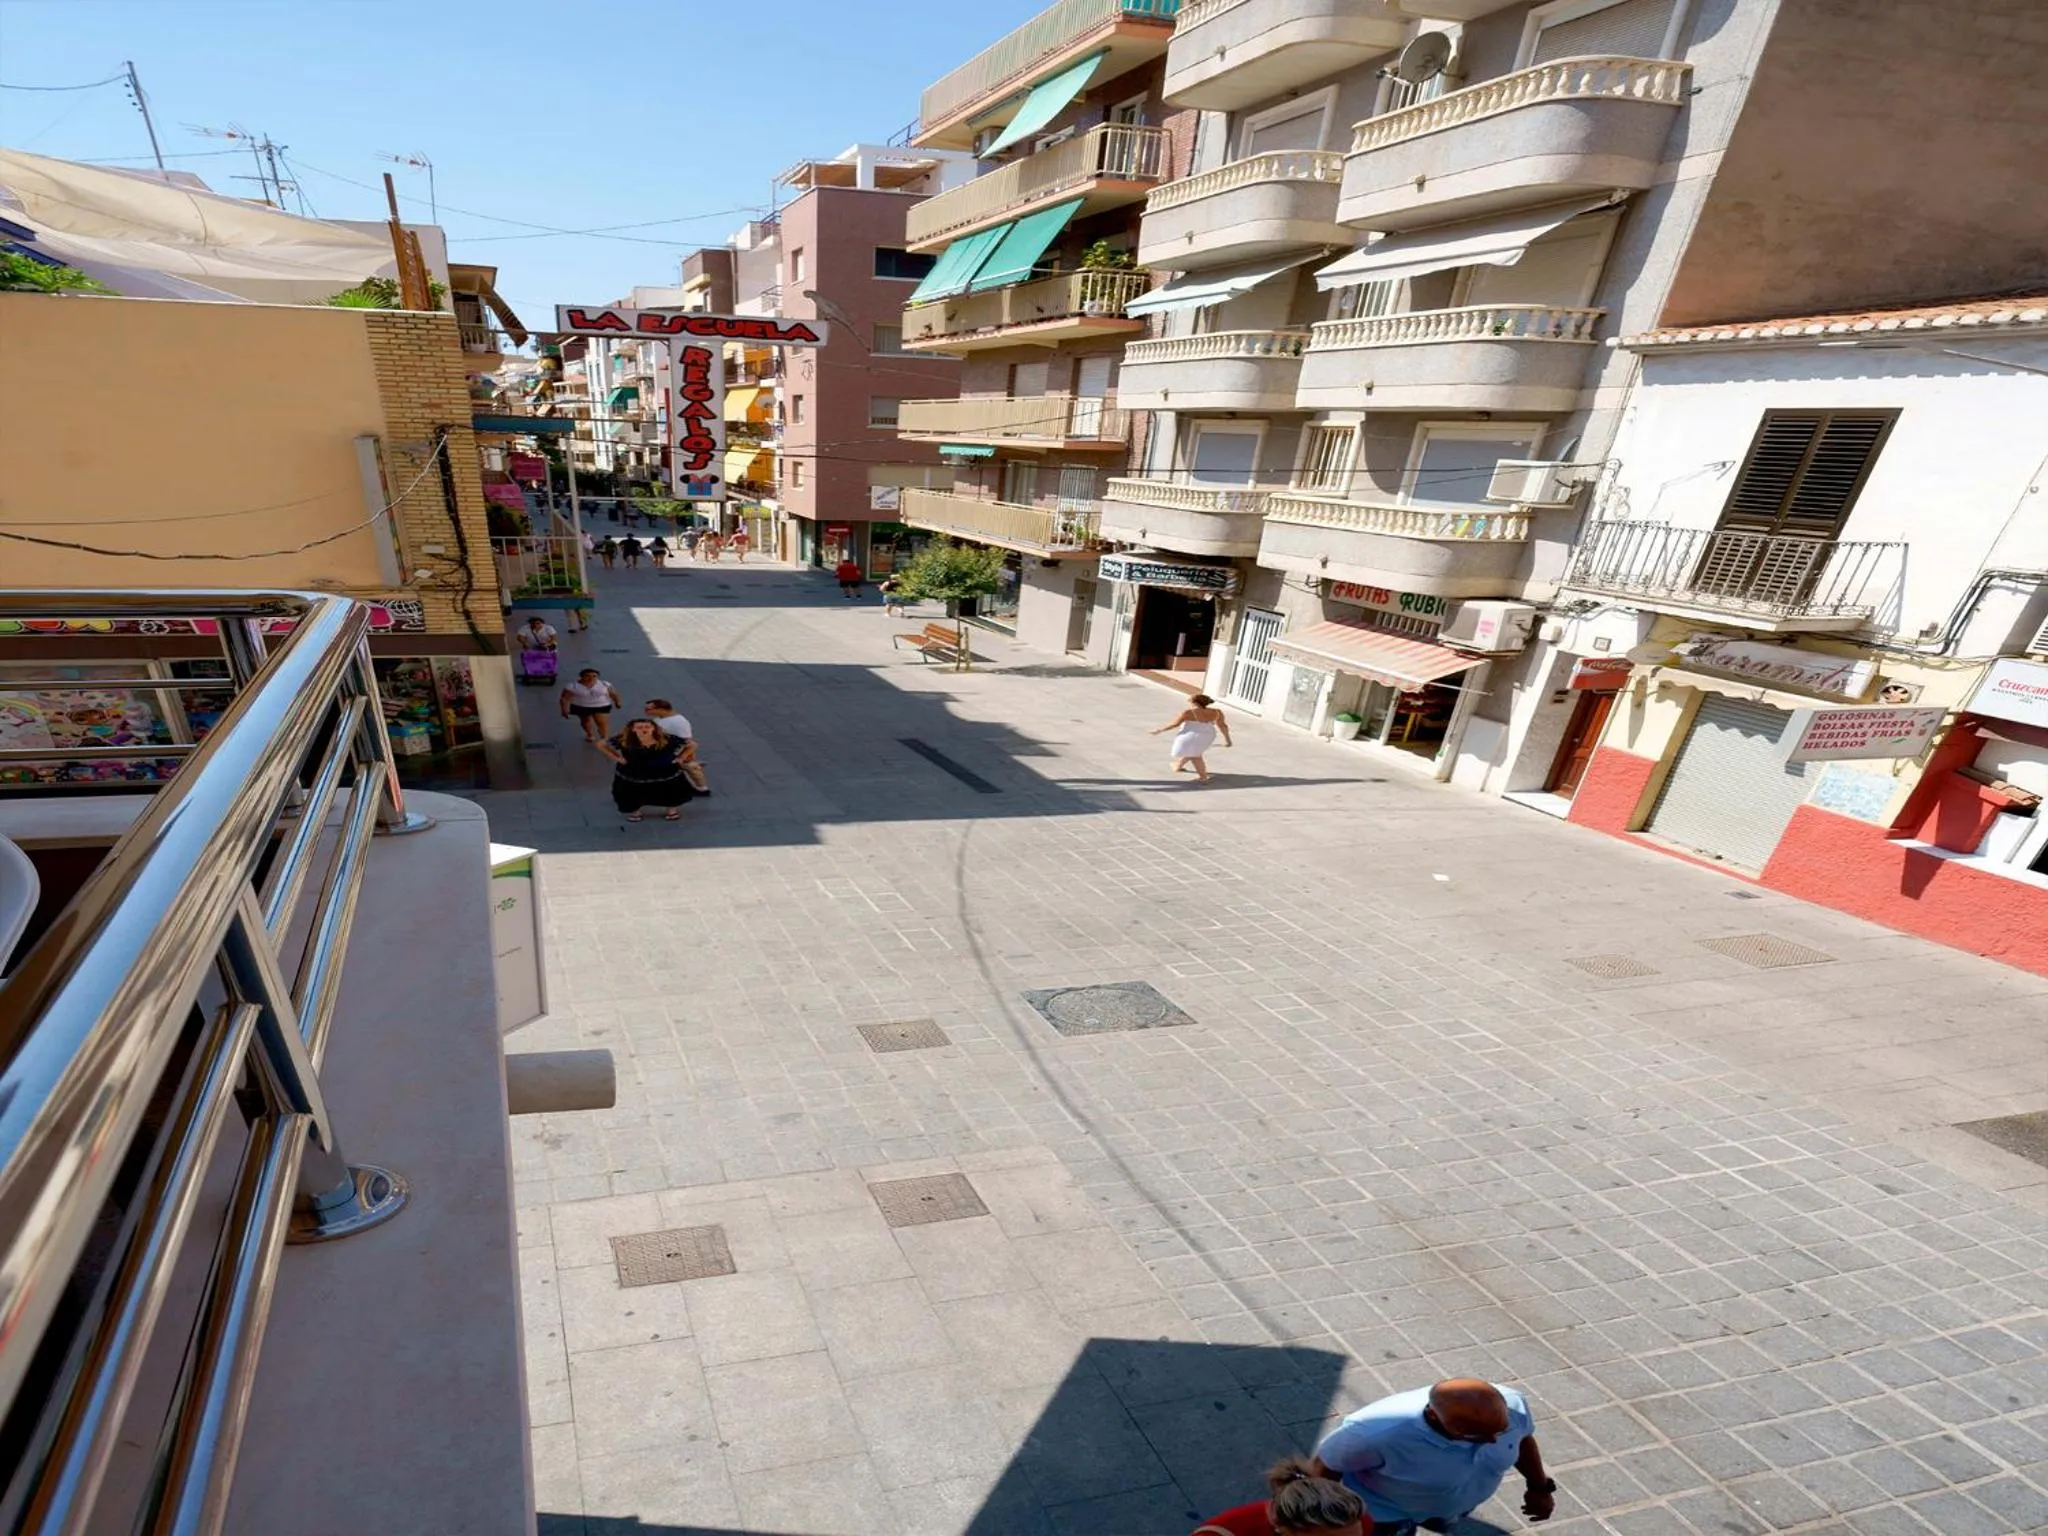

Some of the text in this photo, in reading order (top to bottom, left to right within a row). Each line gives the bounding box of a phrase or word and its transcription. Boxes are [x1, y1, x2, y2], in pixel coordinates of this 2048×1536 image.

[567, 309, 820, 343] LA ESCUELA
[677, 345, 717, 471] REGALOS
[1333, 581, 1392, 605] FRUTAS
[1818, 711, 1896, 721] GOLOSINAS
[1812, 720, 1915, 731] BOLSAS FIESTA
[1808, 730, 1867, 739] BEBIDAS
[1802, 740, 1866, 749] HELADOS
